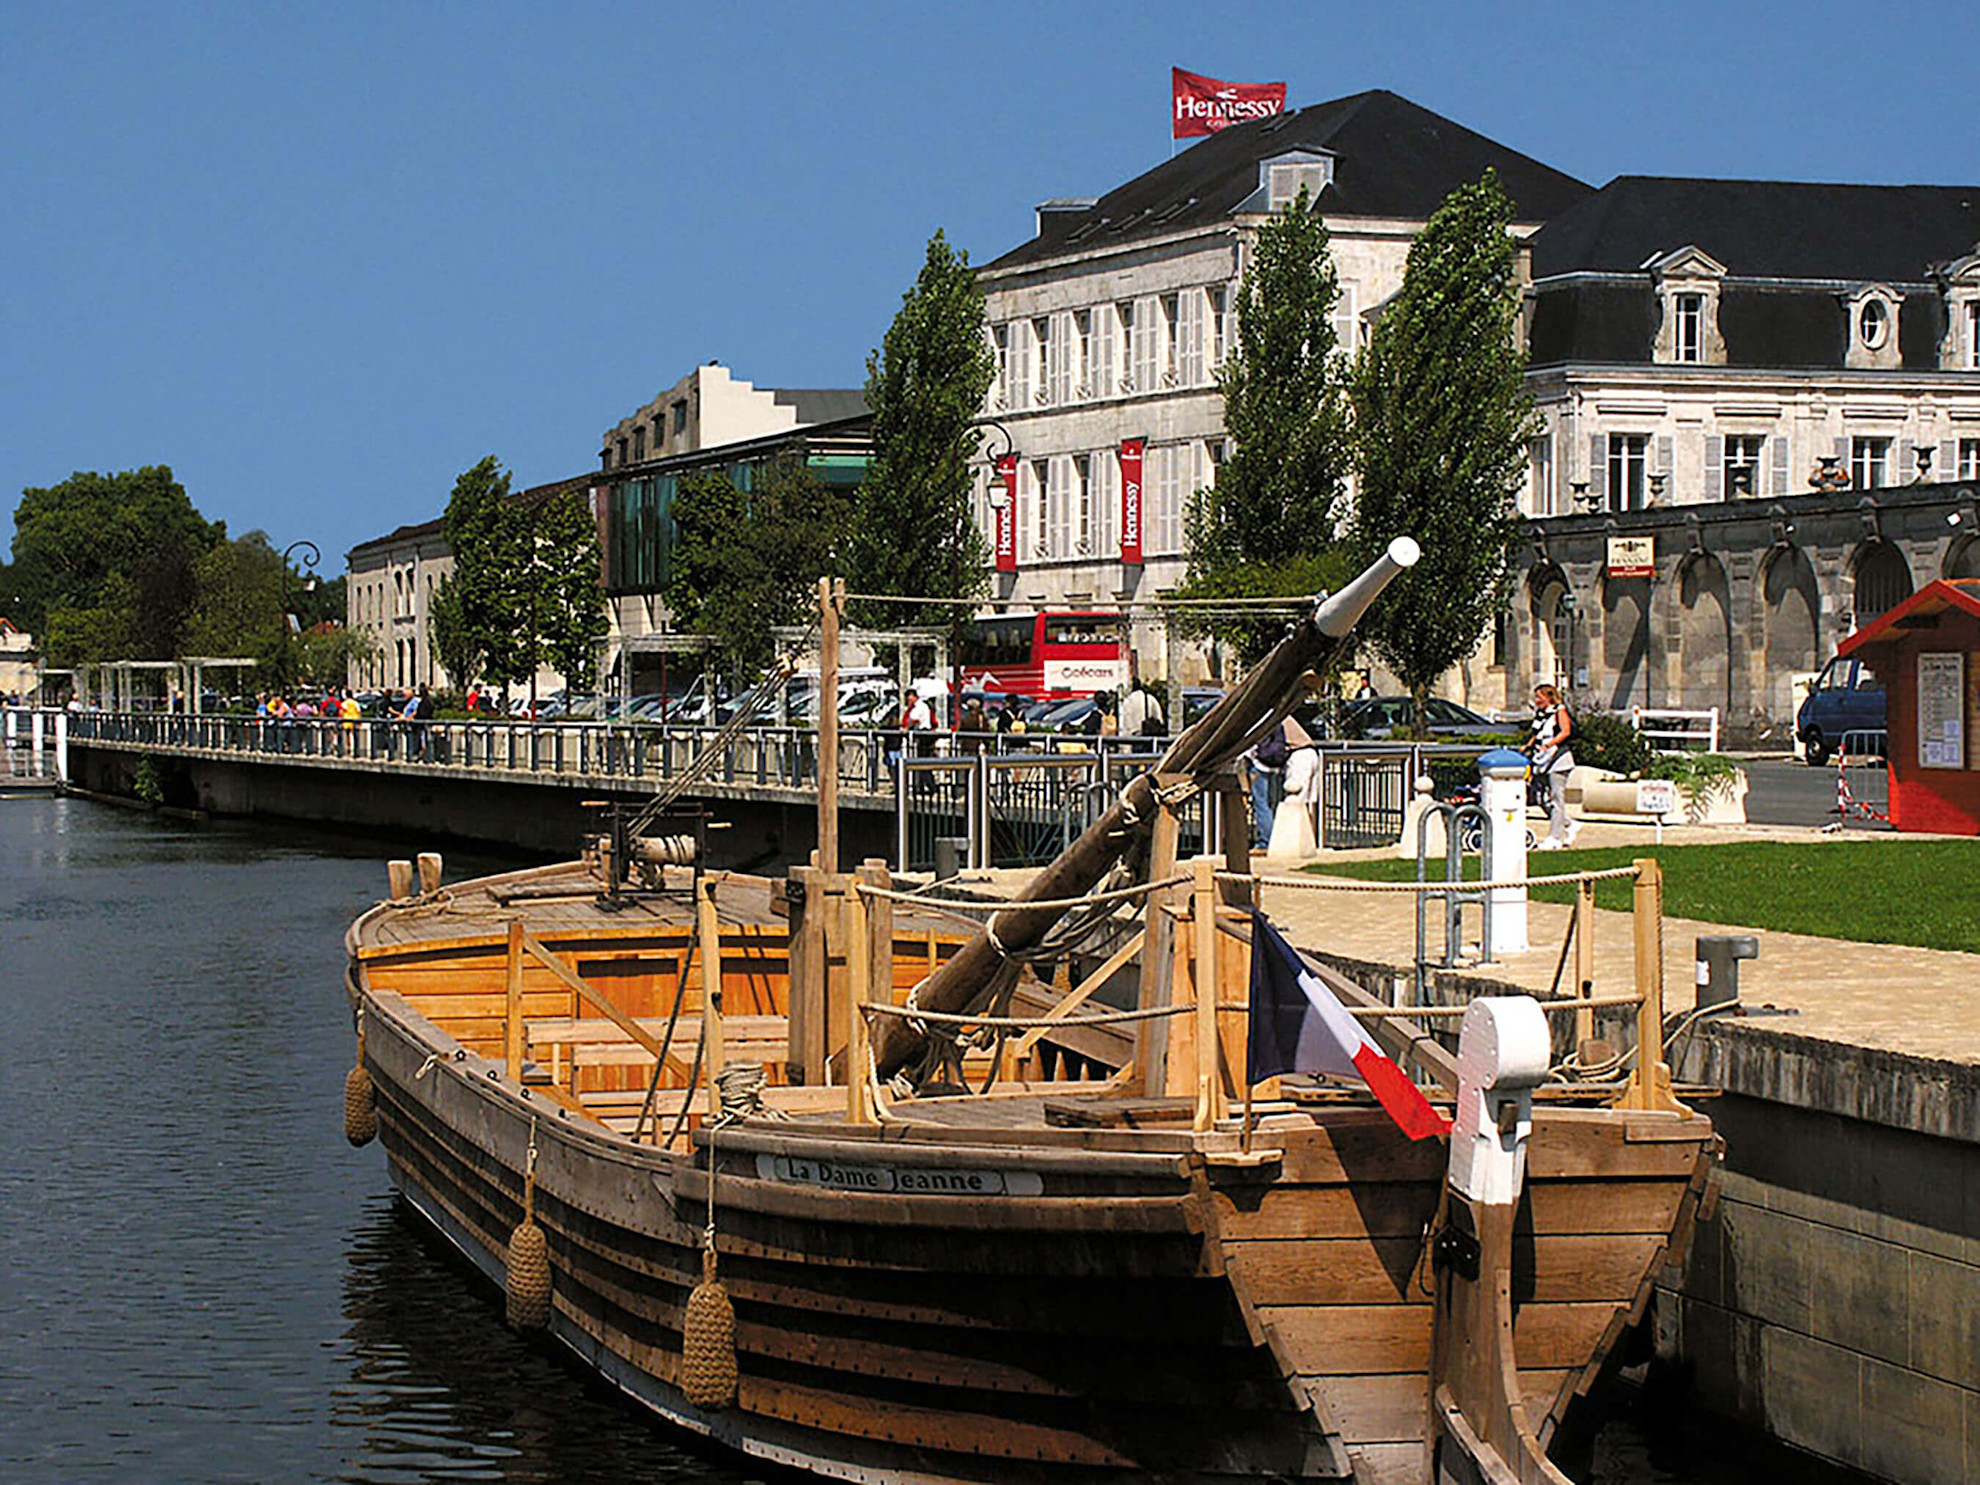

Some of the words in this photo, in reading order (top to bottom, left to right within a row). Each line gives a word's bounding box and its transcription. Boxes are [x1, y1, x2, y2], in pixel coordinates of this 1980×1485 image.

[1176, 96, 1281, 119] Hennessy
[1123, 480, 1140, 546] Hennessy
[788, 1157, 810, 1180] La
[818, 1163, 878, 1187] Dame
[887, 1169, 983, 1192] Jeanne
